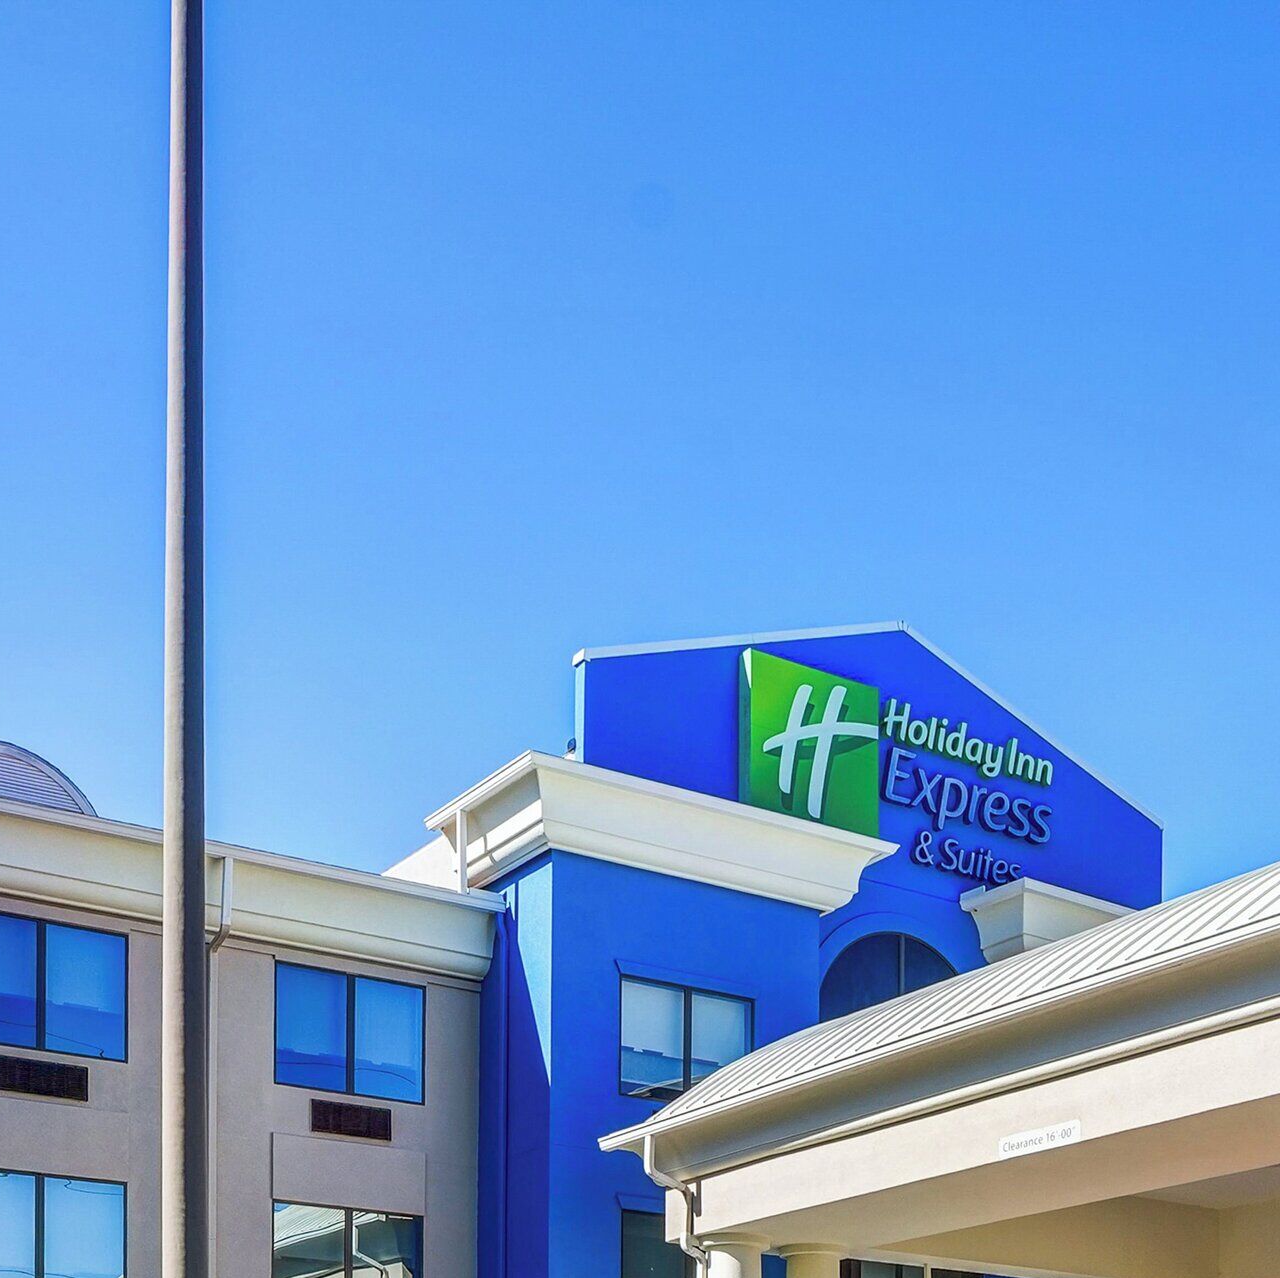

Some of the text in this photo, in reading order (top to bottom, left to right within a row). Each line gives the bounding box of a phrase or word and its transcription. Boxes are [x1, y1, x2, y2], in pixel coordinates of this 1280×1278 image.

[883, 698, 1054, 786] Holiday Inn
[885, 746, 1053, 843] Express
[914, 831, 1021, 884] & Suites
[1002, 1135, 1044, 1153] Clearance
